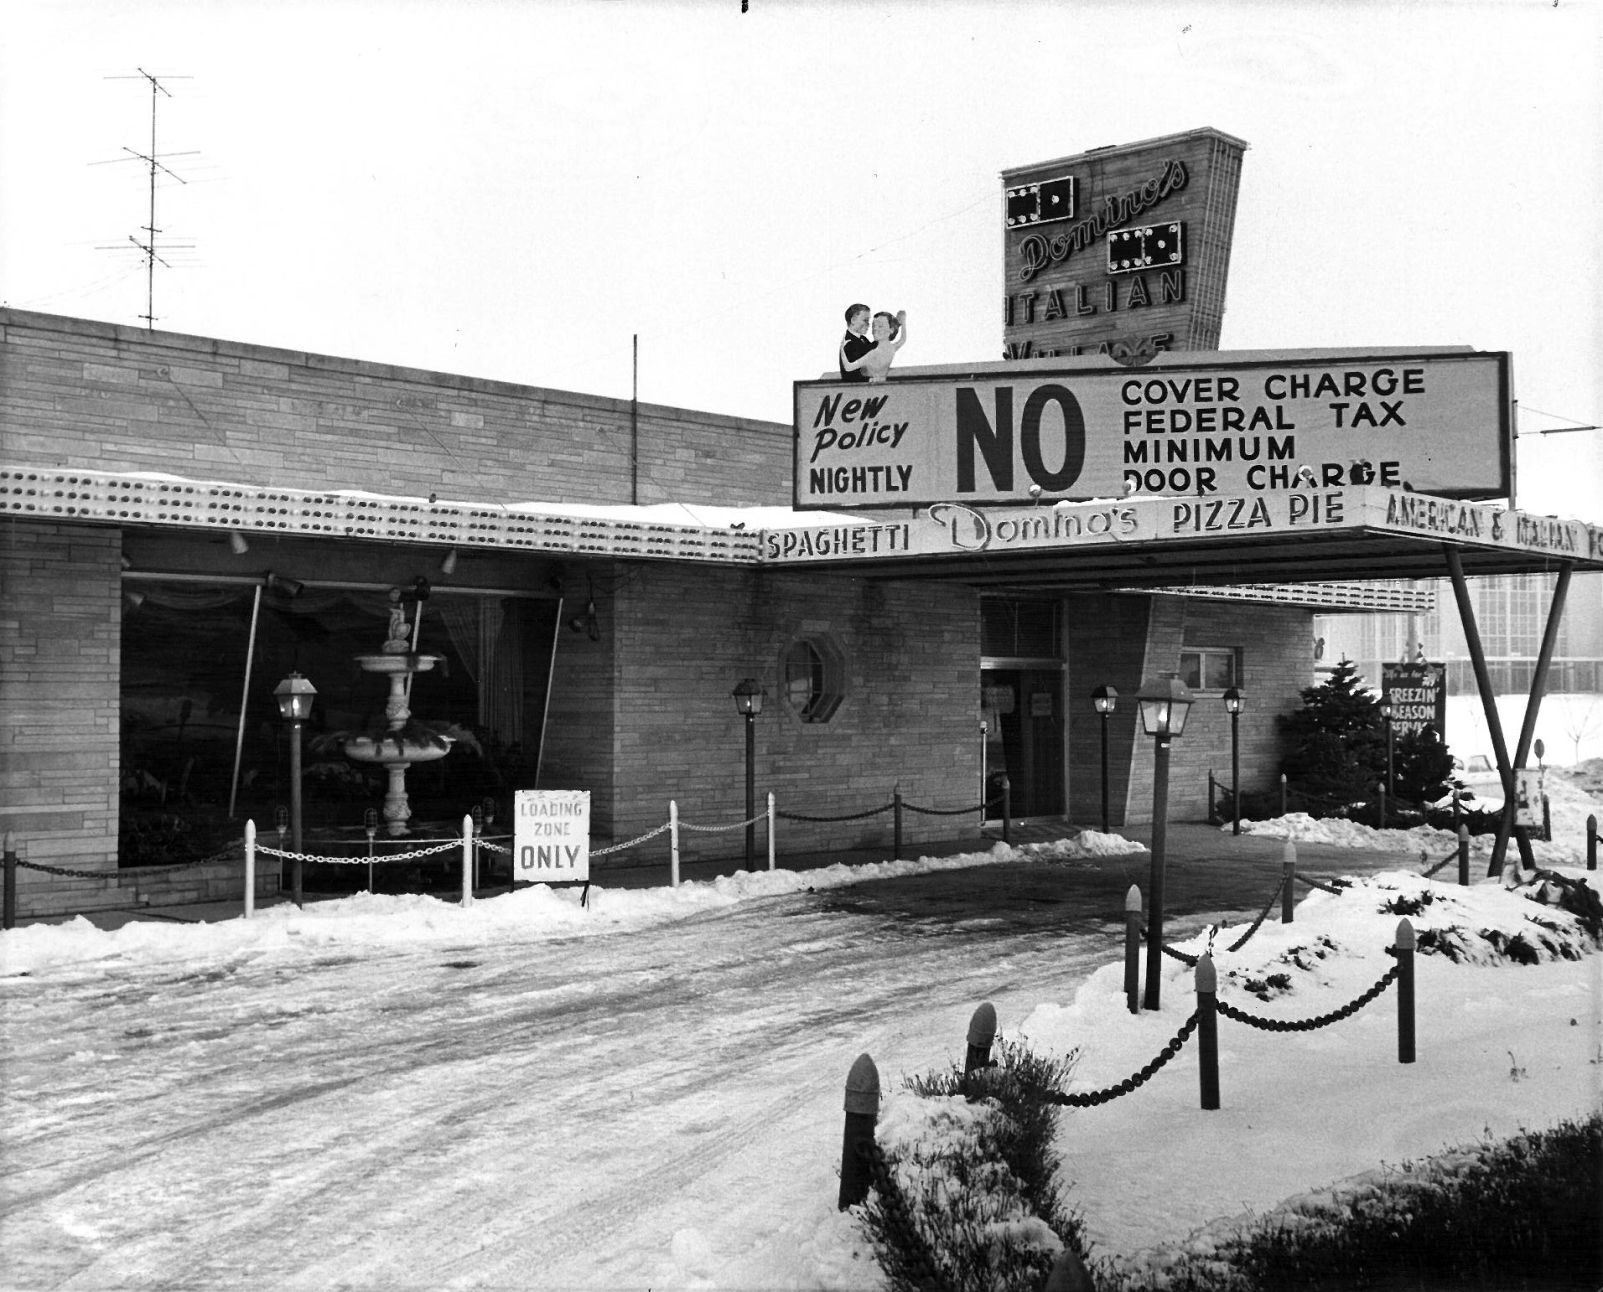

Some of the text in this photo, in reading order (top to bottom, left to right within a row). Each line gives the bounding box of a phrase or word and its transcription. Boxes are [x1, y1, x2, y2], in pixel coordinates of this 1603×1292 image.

[1018, 159, 1188, 281] Domino's
[1004, 269, 1185, 326] ITALIAN
[1121, 368, 1426, 406] COVER CHARGE
[813, 392, 888, 428] New
[1124, 400, 1408, 435] FEDERAL TAX
[810, 422, 909, 463] Policy
[956, 383, 1086, 493] NO
[1123, 435, 1296, 464] MINIMUM
[810, 464, 913, 494] NIGHTLY
[1124, 461, 1401, 495] DOOR CHARGE
[1173, 491, 1344, 534] PIZZA PIE
[767, 524, 910, 559] SPAGHETTI
[521, 802, 582, 817] LOADING
[534, 822, 571, 836] ZONE
[520, 845, 581, 870] ONLY
